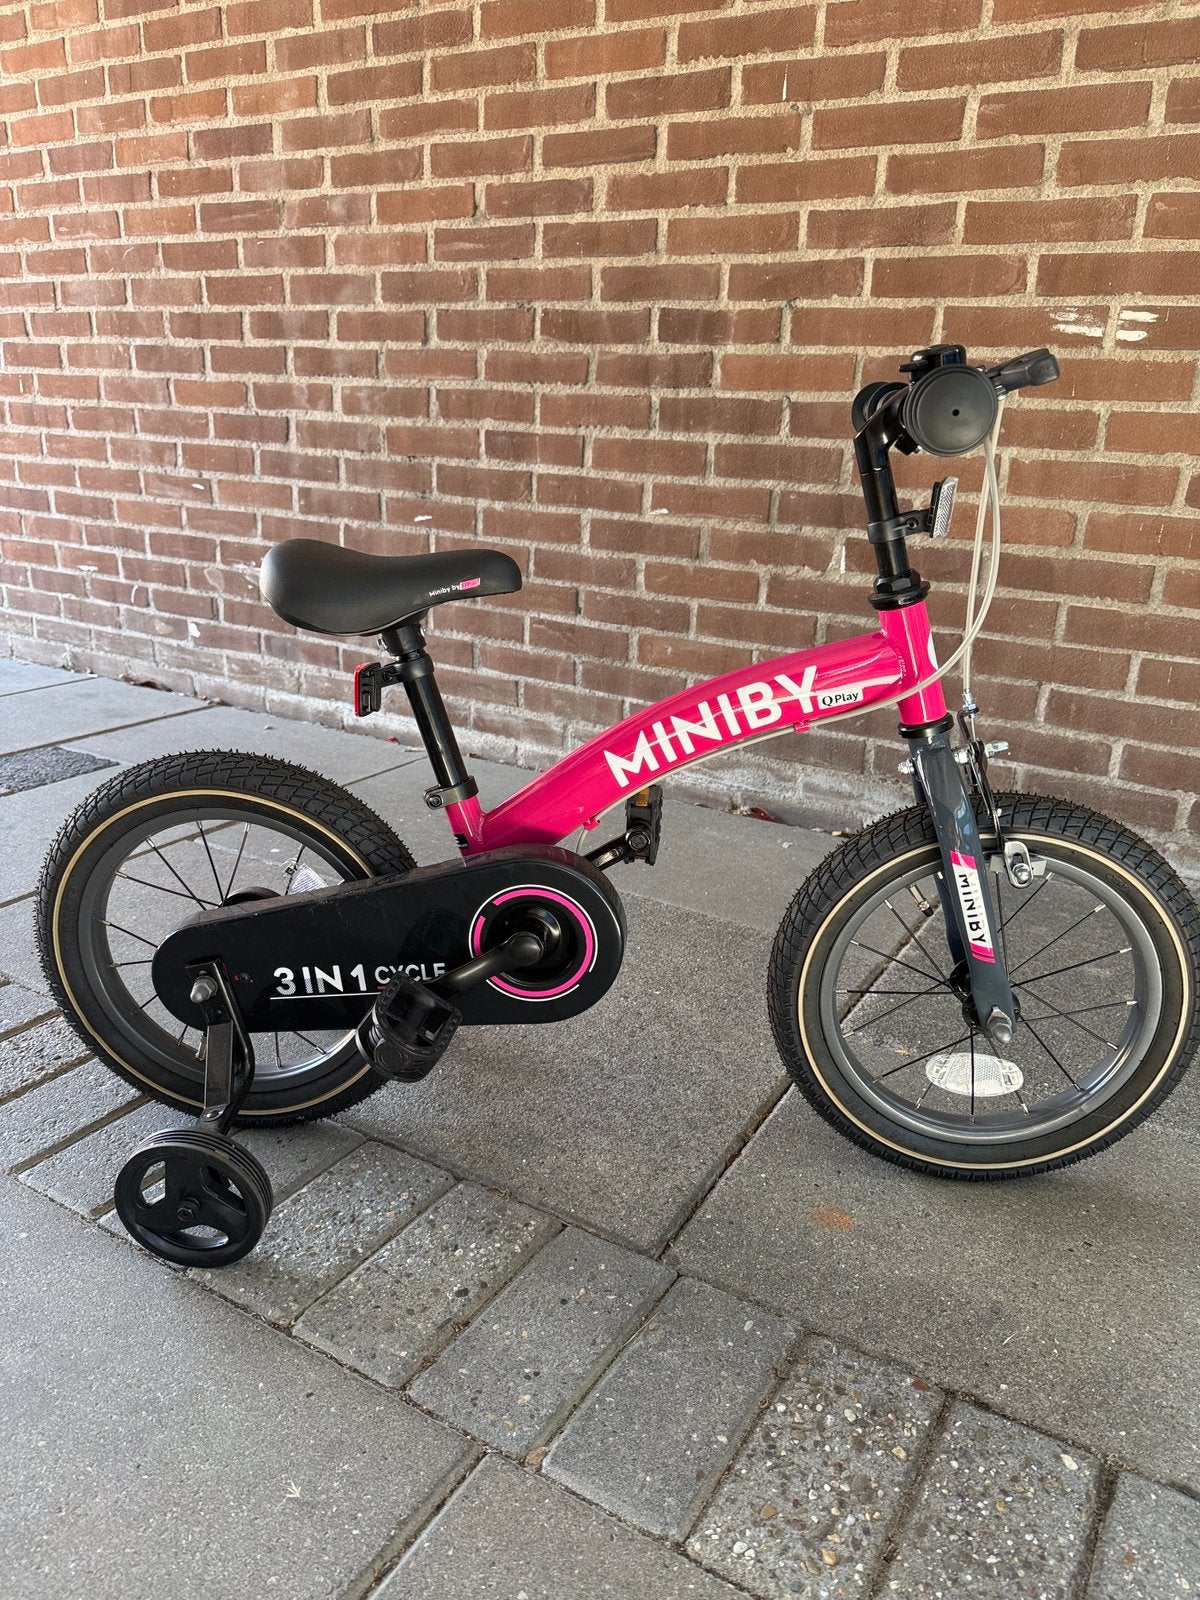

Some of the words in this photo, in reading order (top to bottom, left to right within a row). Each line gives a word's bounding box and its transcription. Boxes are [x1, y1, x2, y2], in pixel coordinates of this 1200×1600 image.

[429, 587, 450, 597] Miniby
[603, 665, 818, 788] MINIBY
[958, 873, 987, 943] MINIBY
